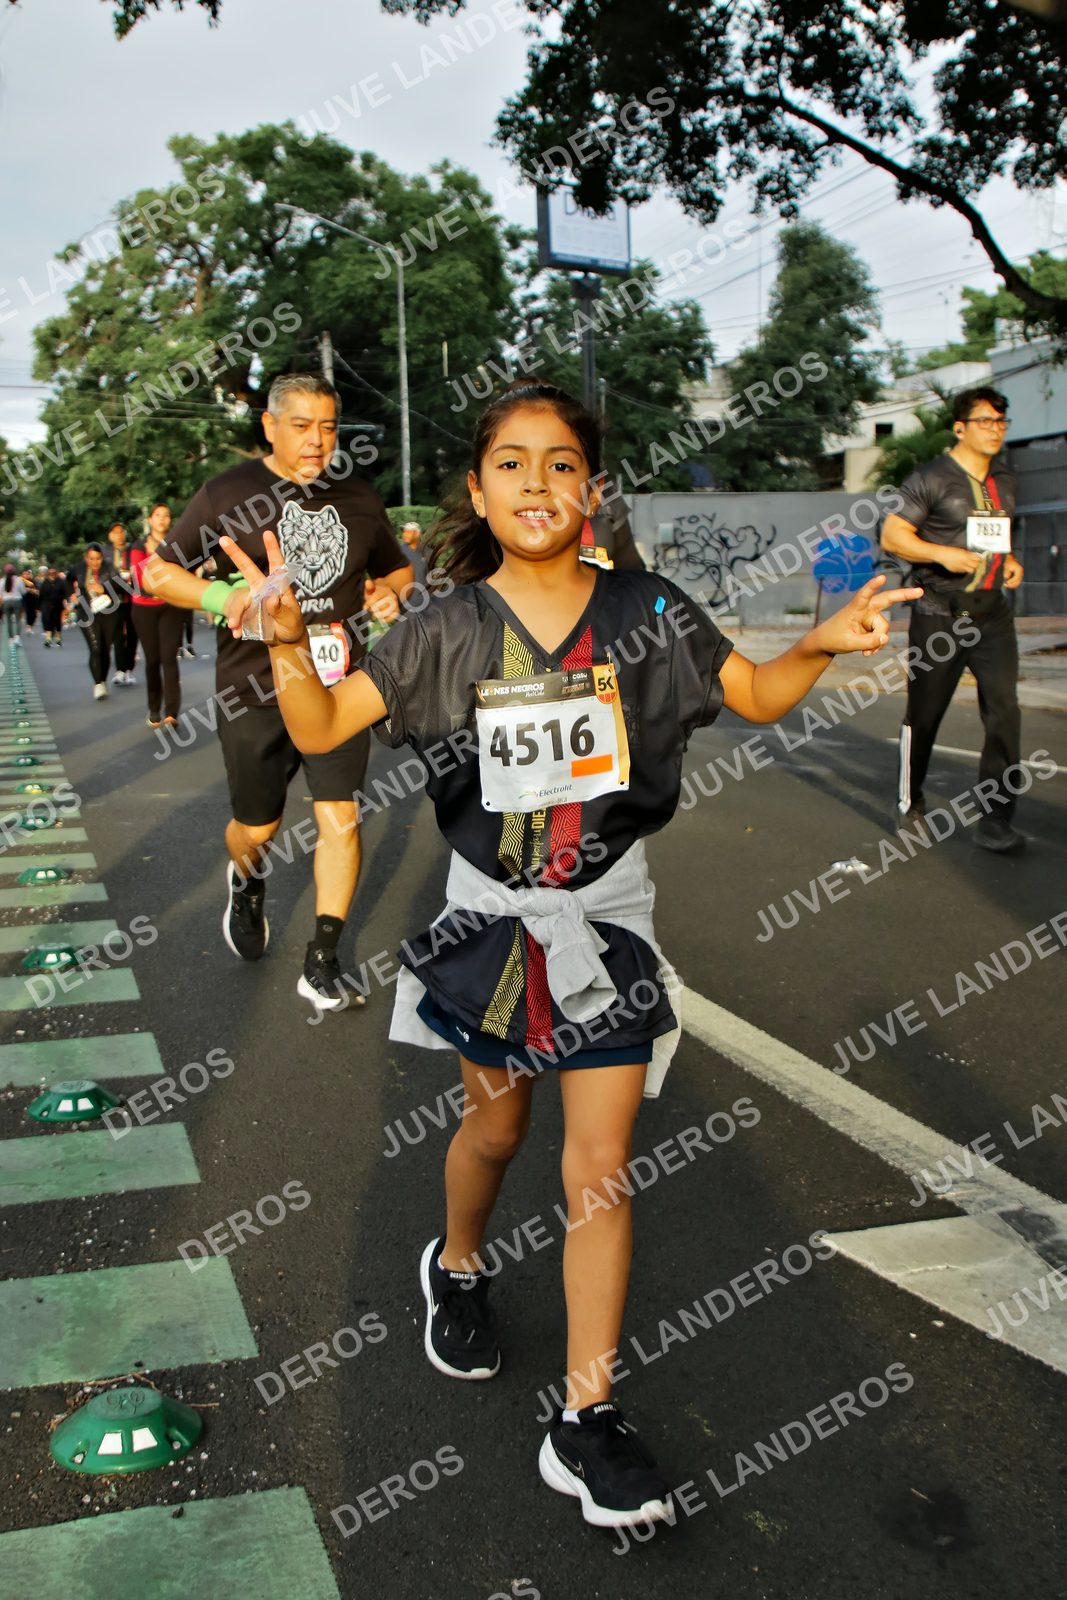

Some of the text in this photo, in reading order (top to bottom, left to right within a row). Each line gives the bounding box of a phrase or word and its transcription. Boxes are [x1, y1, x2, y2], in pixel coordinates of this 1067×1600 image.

[673, 512, 716, 527] TOY
[511, 682, 545, 694] NEGROS
[490, 713, 595, 767] 4516
[531, 807, 547, 829] DIE
